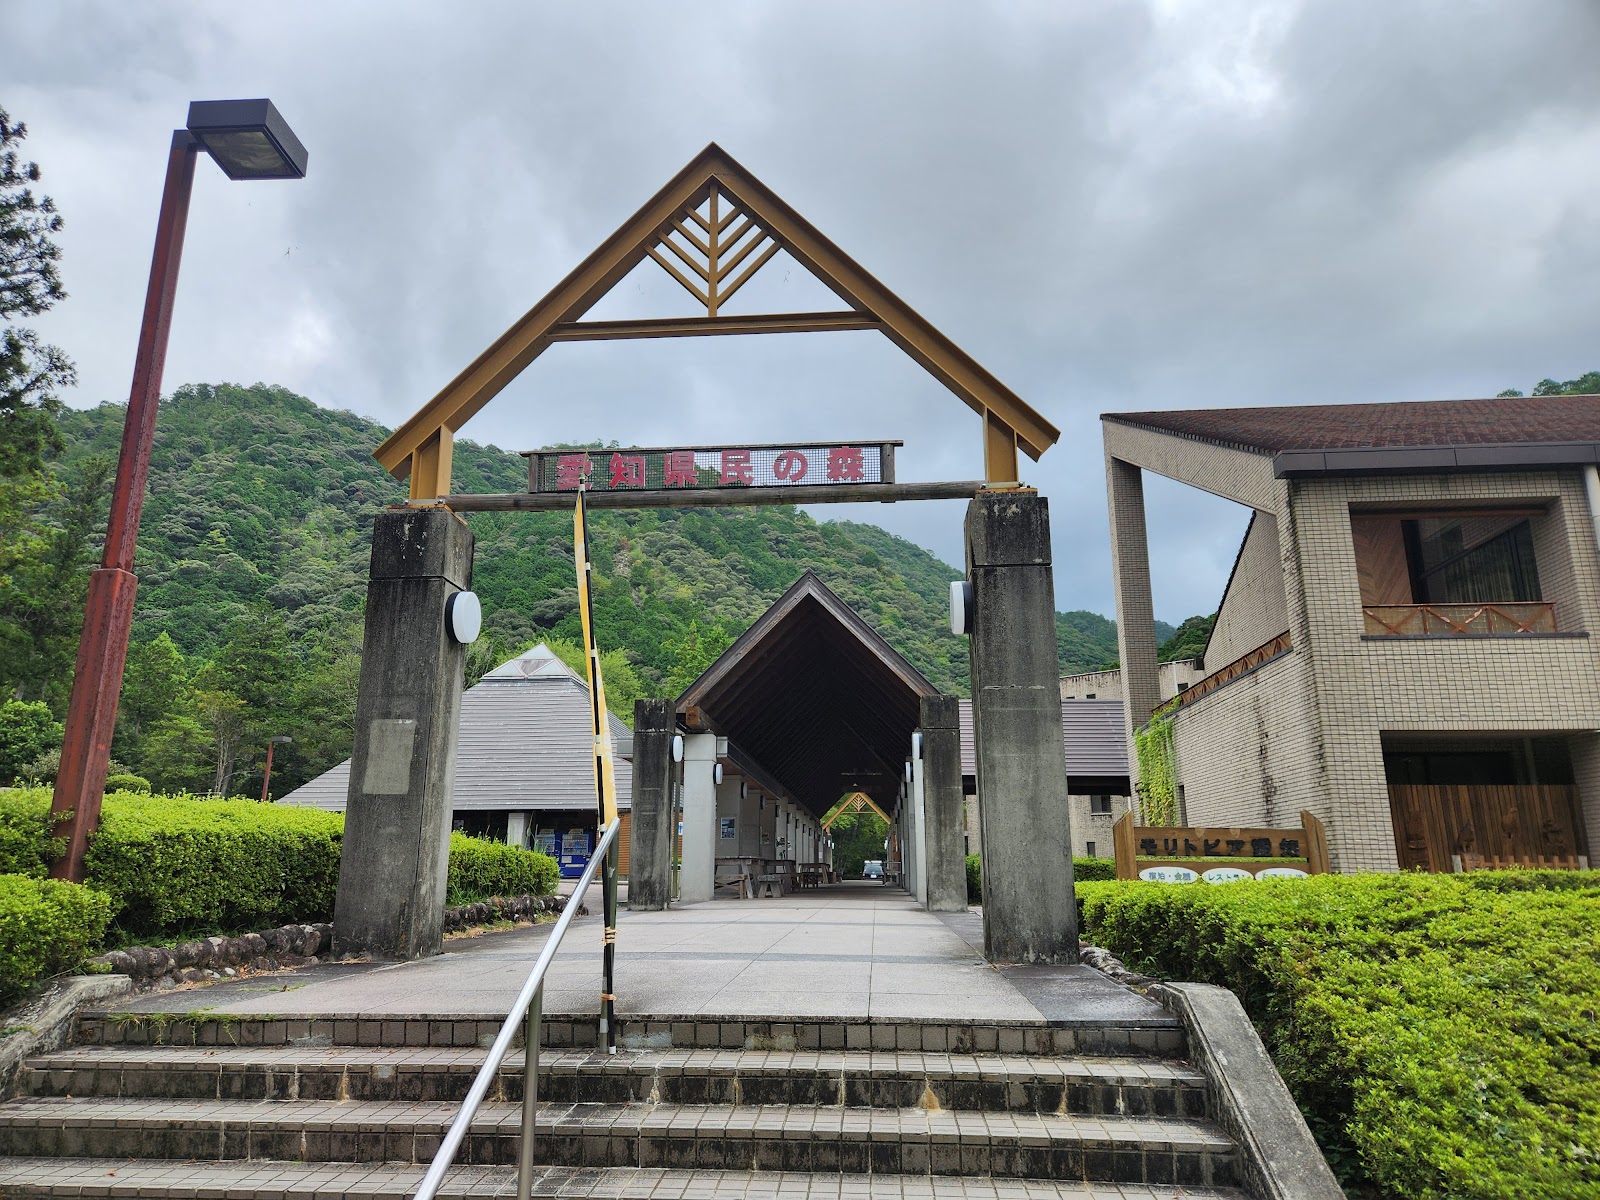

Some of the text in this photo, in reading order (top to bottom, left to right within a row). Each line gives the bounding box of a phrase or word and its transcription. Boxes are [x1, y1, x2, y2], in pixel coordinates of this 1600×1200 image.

[556, 446, 865, 490] 愛知県民の森
[1140, 838, 1299, 857] モリトピア愛知
